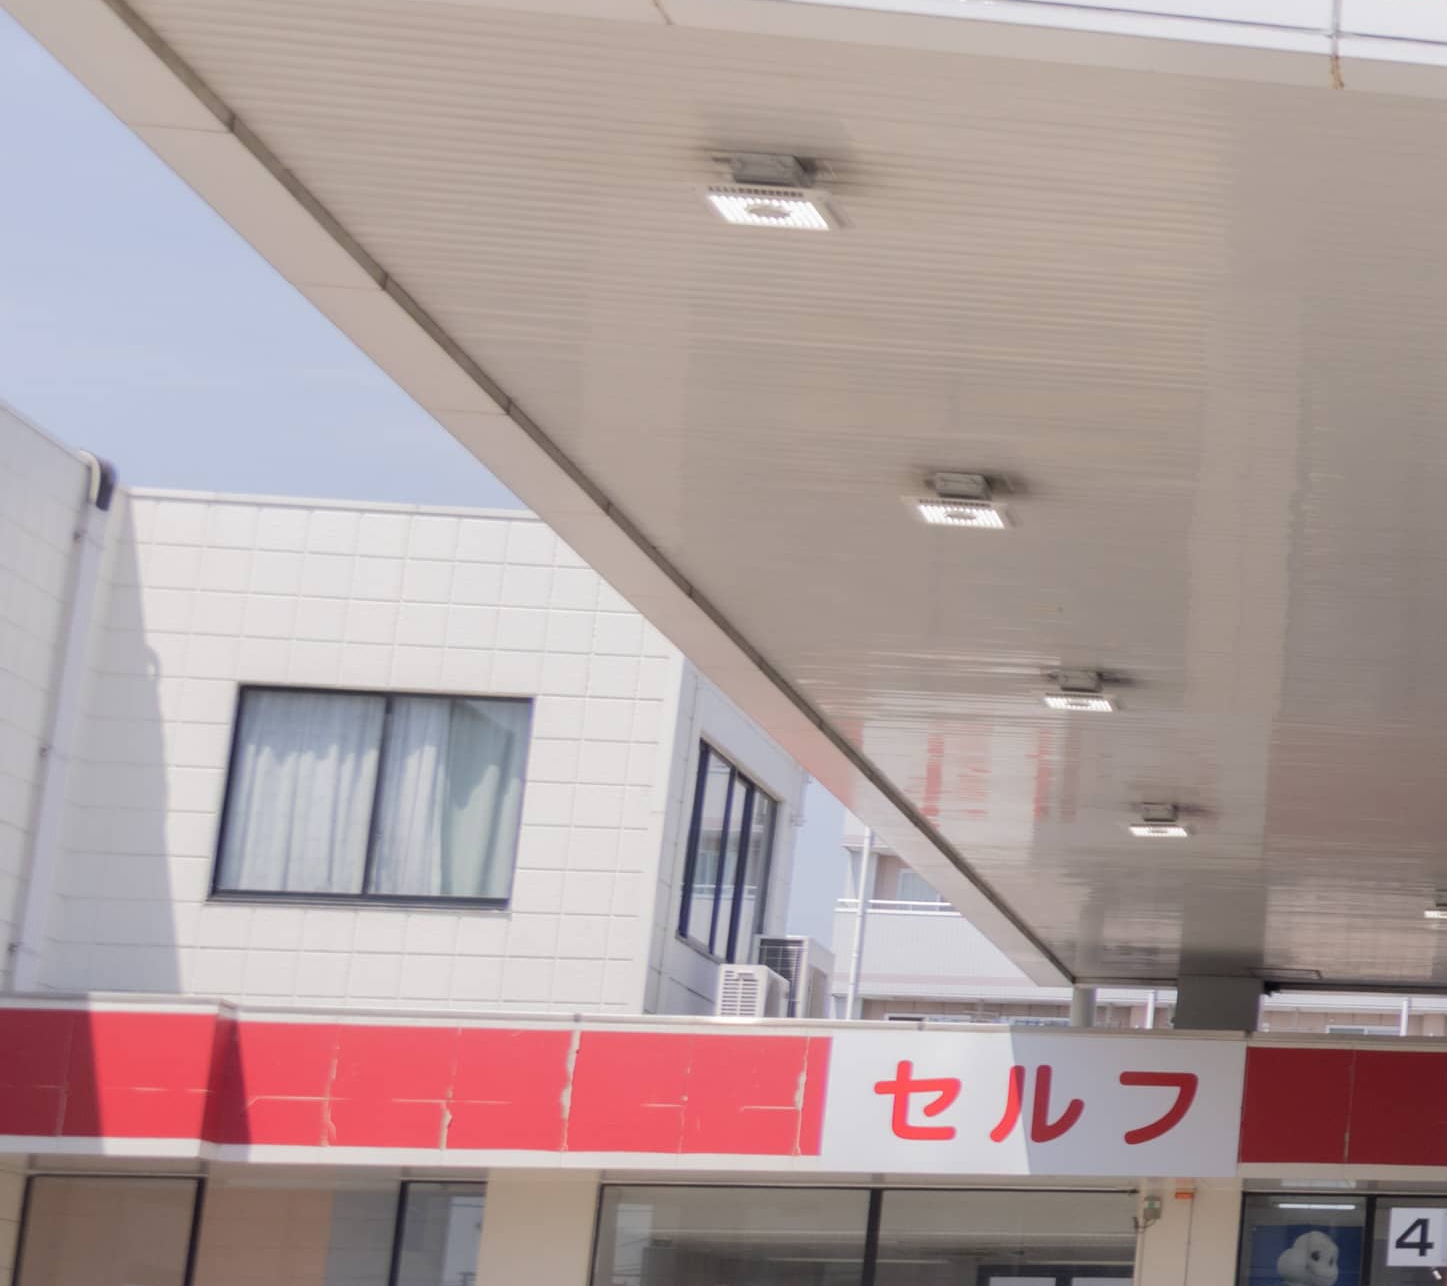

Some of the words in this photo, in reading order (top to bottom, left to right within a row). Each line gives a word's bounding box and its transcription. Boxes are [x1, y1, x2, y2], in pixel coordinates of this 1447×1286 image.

[873, 1059, 1199, 1146] セルフ
[1395, 1217, 1435, 1258] 4
